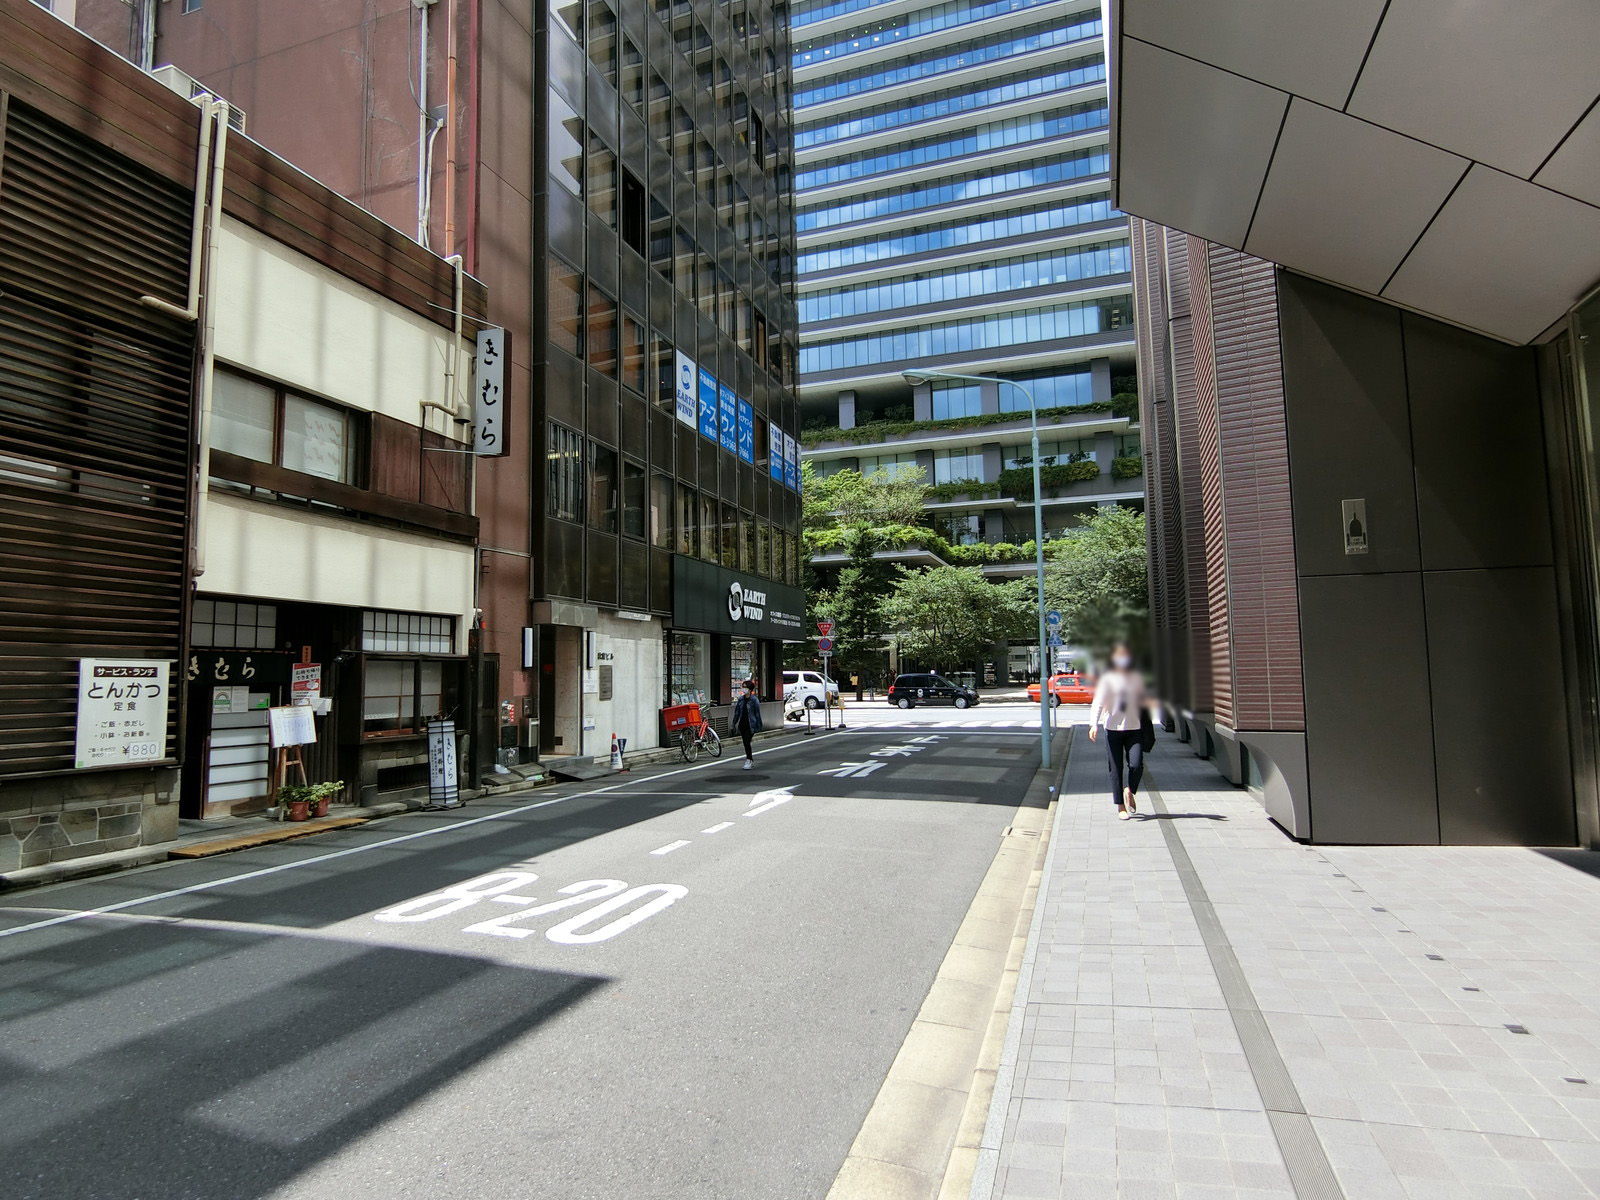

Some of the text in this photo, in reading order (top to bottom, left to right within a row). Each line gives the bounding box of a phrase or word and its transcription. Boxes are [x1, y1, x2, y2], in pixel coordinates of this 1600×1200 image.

[482, 338, 499, 446] きむら
[676, 388, 696, 409] EARTH
[676, 402, 693, 419] WIND
[743, 588, 767, 606] EARTH
[743, 605, 763, 621] WIND
[97, 667, 155, 677] サービス・ランチ
[187, 655, 256, 681] きむら
[87, 681, 161, 699] とんかつ
[113, 701, 137, 712] 定食
[122, 743, 157, 756] ¥980
[446, 737, 454, 780] きむら
[373, 870, 689, 945] 8-20
